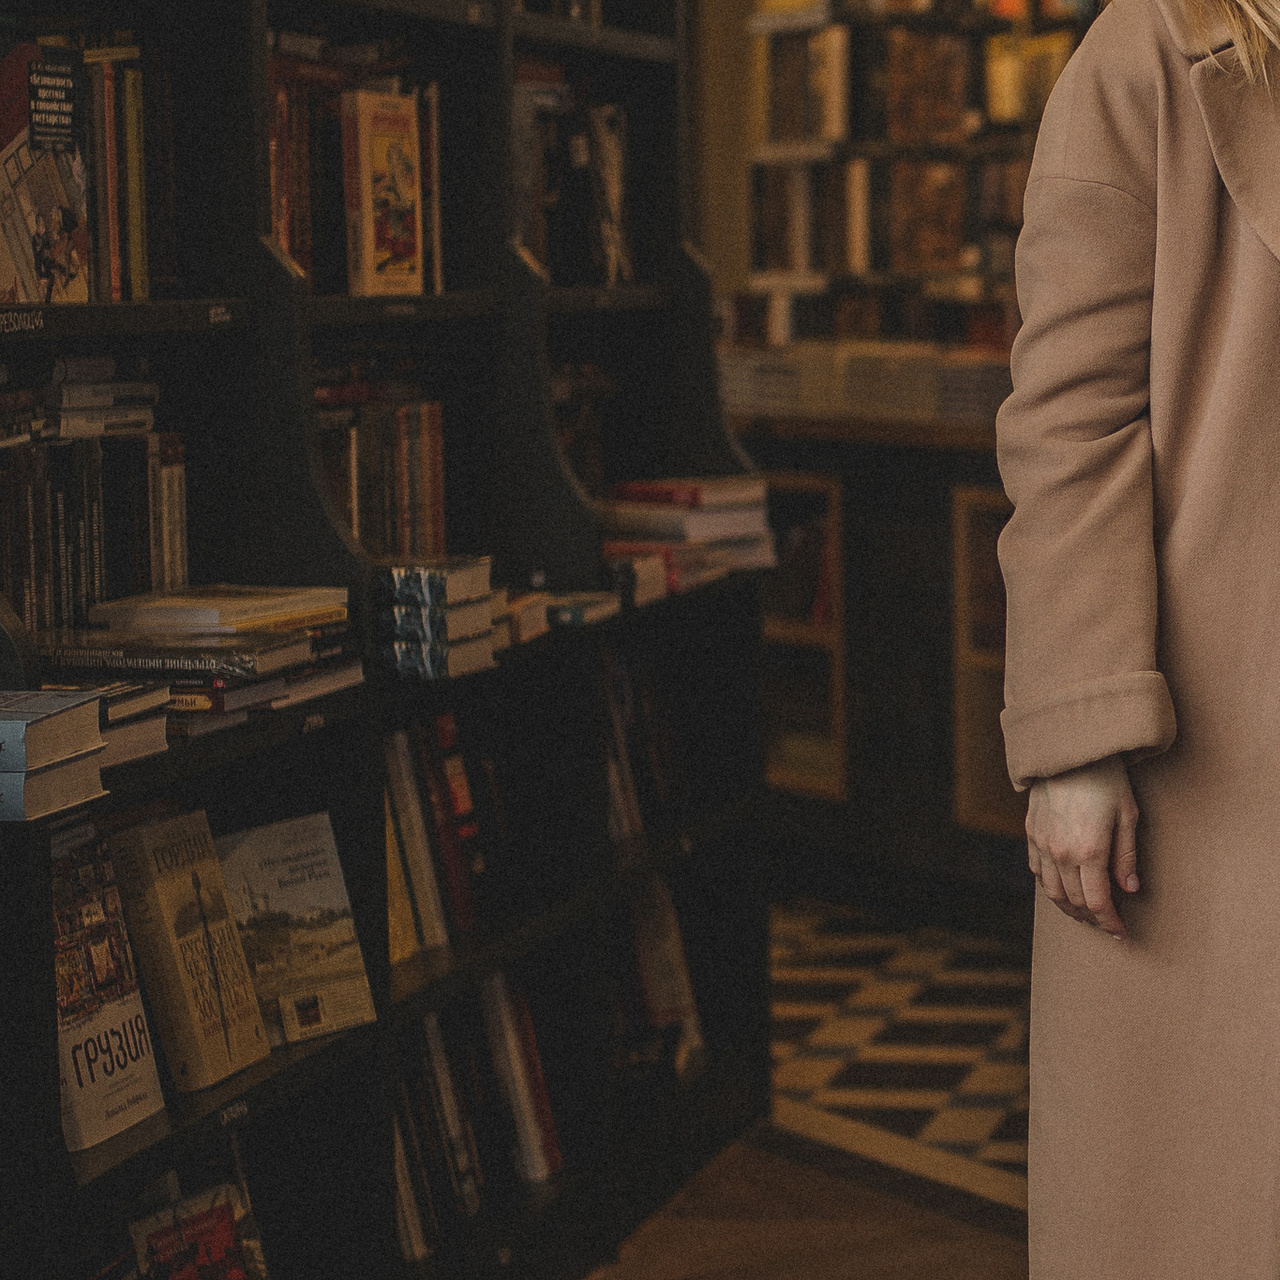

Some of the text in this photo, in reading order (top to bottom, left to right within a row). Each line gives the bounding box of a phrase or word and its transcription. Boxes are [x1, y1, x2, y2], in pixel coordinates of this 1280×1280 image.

[105, 657, 162, 670] ИМПЕРАТОРА
[165, 658, 217, 670] ОТРЕЧЕНИЕ
[72, 1014, 150, 1088] ГРУЗИЯ
